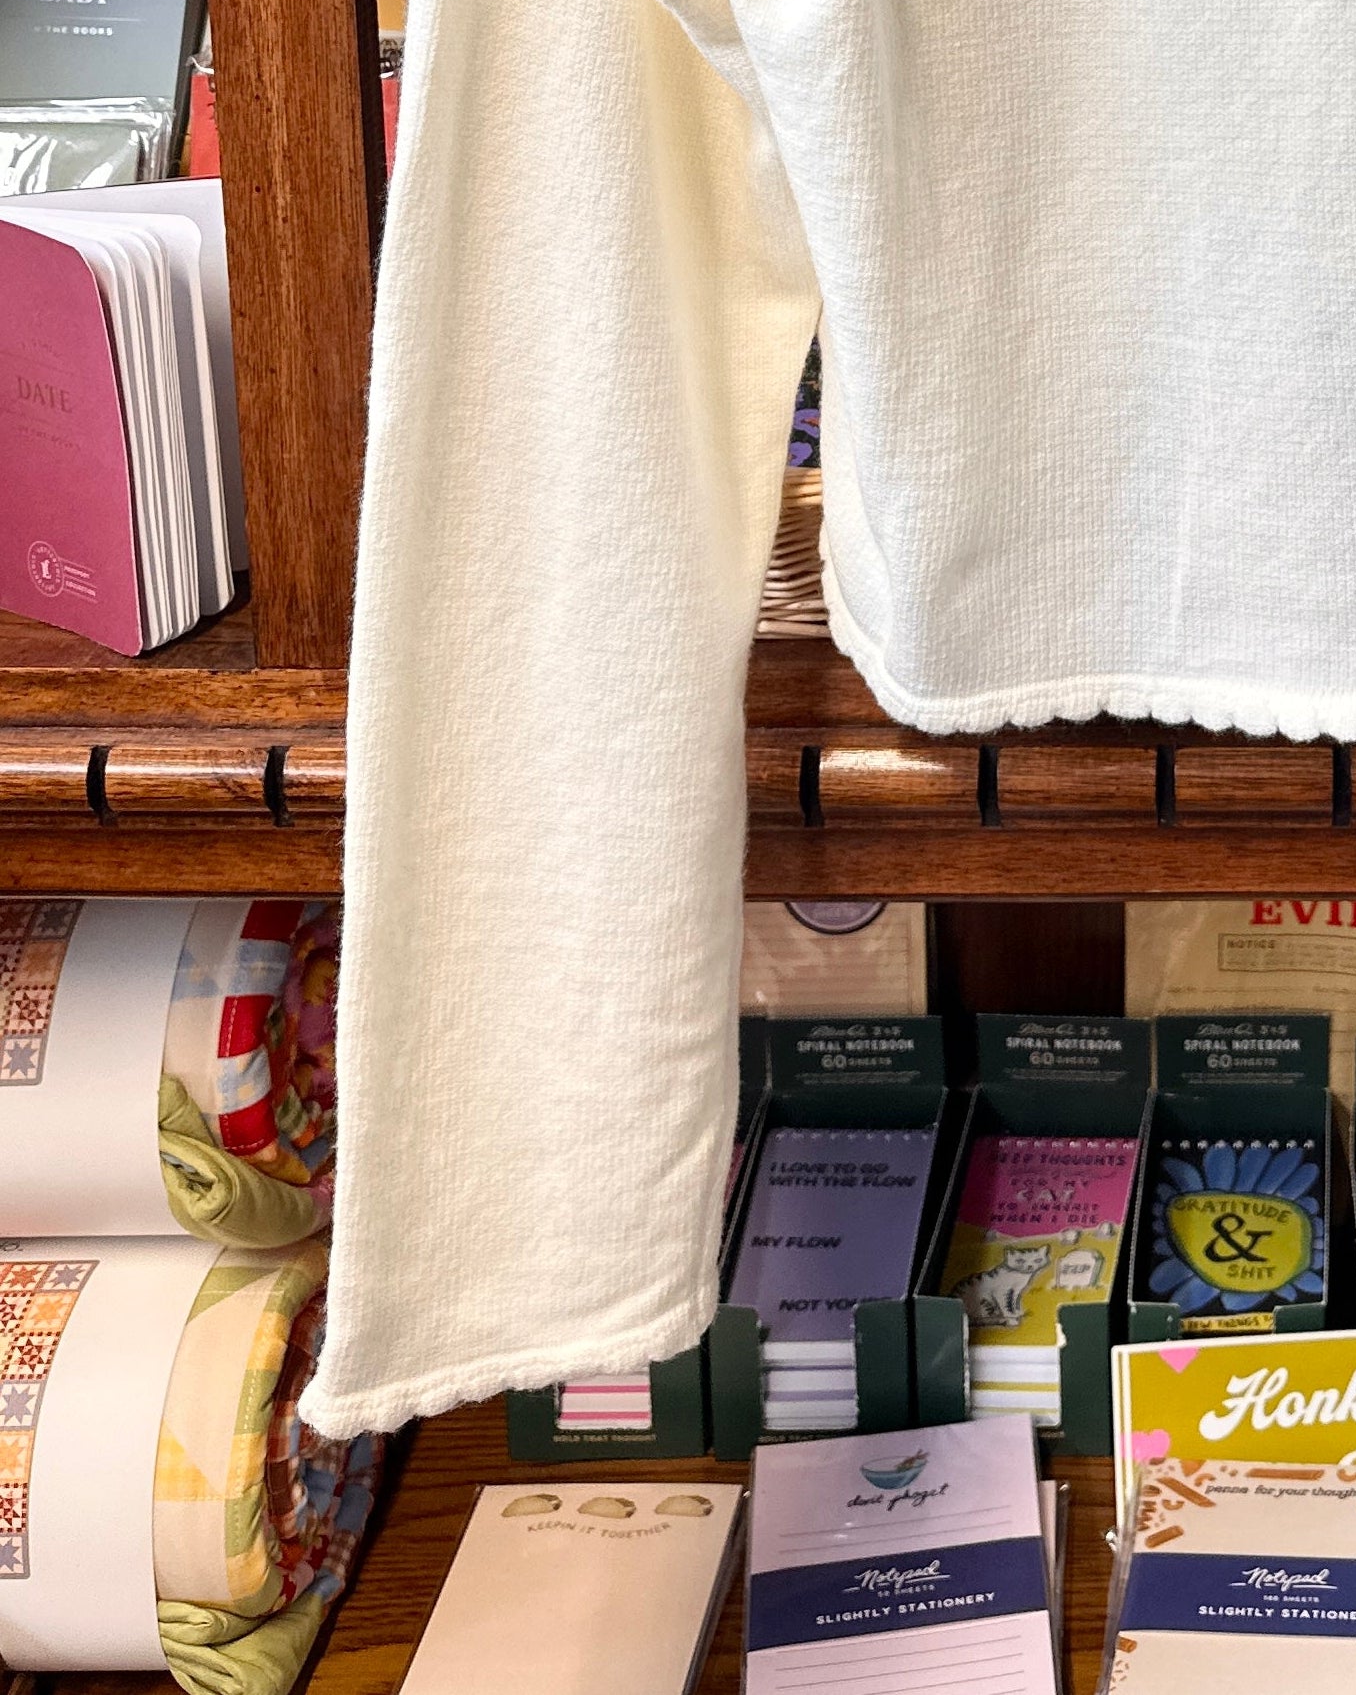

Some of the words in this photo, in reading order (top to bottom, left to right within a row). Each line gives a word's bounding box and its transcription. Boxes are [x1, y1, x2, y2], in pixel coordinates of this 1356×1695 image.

[17, 375, 72, 413] DATE
[1226, 939, 1277, 950] NOTICE
[797, 1040, 841, 1052] SPIRAL
[845, 1039, 914, 1051] NOTEBOOK
[1005, 1037, 1049, 1049] SPIRAL
[1053, 1039, 1123, 1050] NOTEBOOK
[1183, 1039, 1228, 1051] SPIRAL
[1231, 1038, 1300, 1050] NOTEBOOK
[821, 1055, 846, 1069] 60
[1029, 1052, 1054, 1065] 60
[1207, 1054, 1232, 1068] 60
[1040, 1155, 1126, 1166] THOUGHTS
[770, 1162, 777, 1172] I
[781, 1162, 829, 1173] LOVE
[832, 1163, 857, 1174] TO
[860, 1163, 889, 1174] GO
[769, 1176, 818, 1187] WITH
[823, 1176, 857, 1187] THE
[862, 1176, 917, 1187] FLOW
[1016, 1188, 1075, 1202] CAT
[999, 1203, 1017, 1211] TO
[1031, 1202, 1098, 1212] INHERIT
[1173, 1197, 1292, 1224] GRATITUDE
[991, 1213, 1042, 1223] WHEN
[1068, 1214, 1097, 1223] DIE
[752, 1235, 783, 1248] MY
[786, 1236, 842, 1248] FLOW
[1203, 1213, 1272, 1262] &
[1226, 1263, 1276, 1280] SHIT
[779, 1299, 821, 1311] NOT
[1218, 1315, 1260, 1327] THINGS
[1205, 1484, 1249, 1494] penne
[1254, 1484, 1276, 1495] for
[1274, 1487, 1310, 1498] your
[527, 1520, 576, 1532] KEEPIN
[580, 1526, 595, 1534] IT
[600, 1521, 671, 1539] TOGETHER
[854, 1559, 941, 1591] Notepad
[1242, 1566, 1330, 1592] Notepad
[1282, 1595, 1320, 1603] SHEETS
[815, 1606, 891, 1625] SLIGHTLY
[899, 1592, 996, 1614] STATIONERY
[1198, 1605, 1275, 1617] SLIGHTLY
